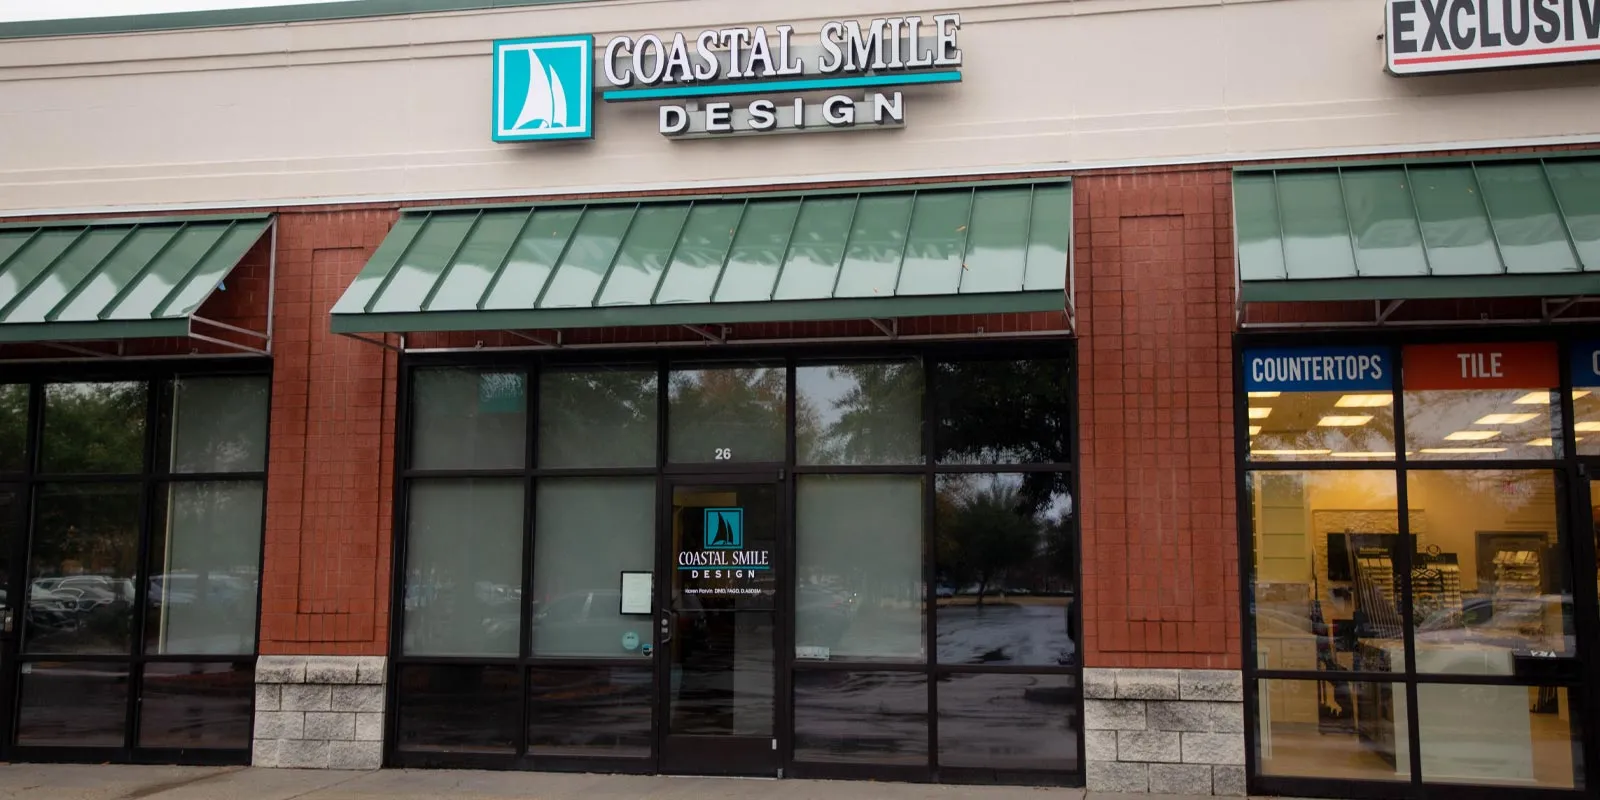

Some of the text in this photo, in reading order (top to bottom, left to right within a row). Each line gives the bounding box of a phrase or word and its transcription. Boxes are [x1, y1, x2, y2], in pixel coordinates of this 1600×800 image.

[604, 13, 962, 87] COASTAL SMILE
[660, 92, 904, 135] DESIGN
[1252, 355, 1383, 383] COUNTERTOPS
[1457, 352, 1504, 379] TILE
[715, 447, 732, 460] 26
[678, 550, 769, 566] COASTAL SMILE
[691, 569, 755, 579] DESIGN
